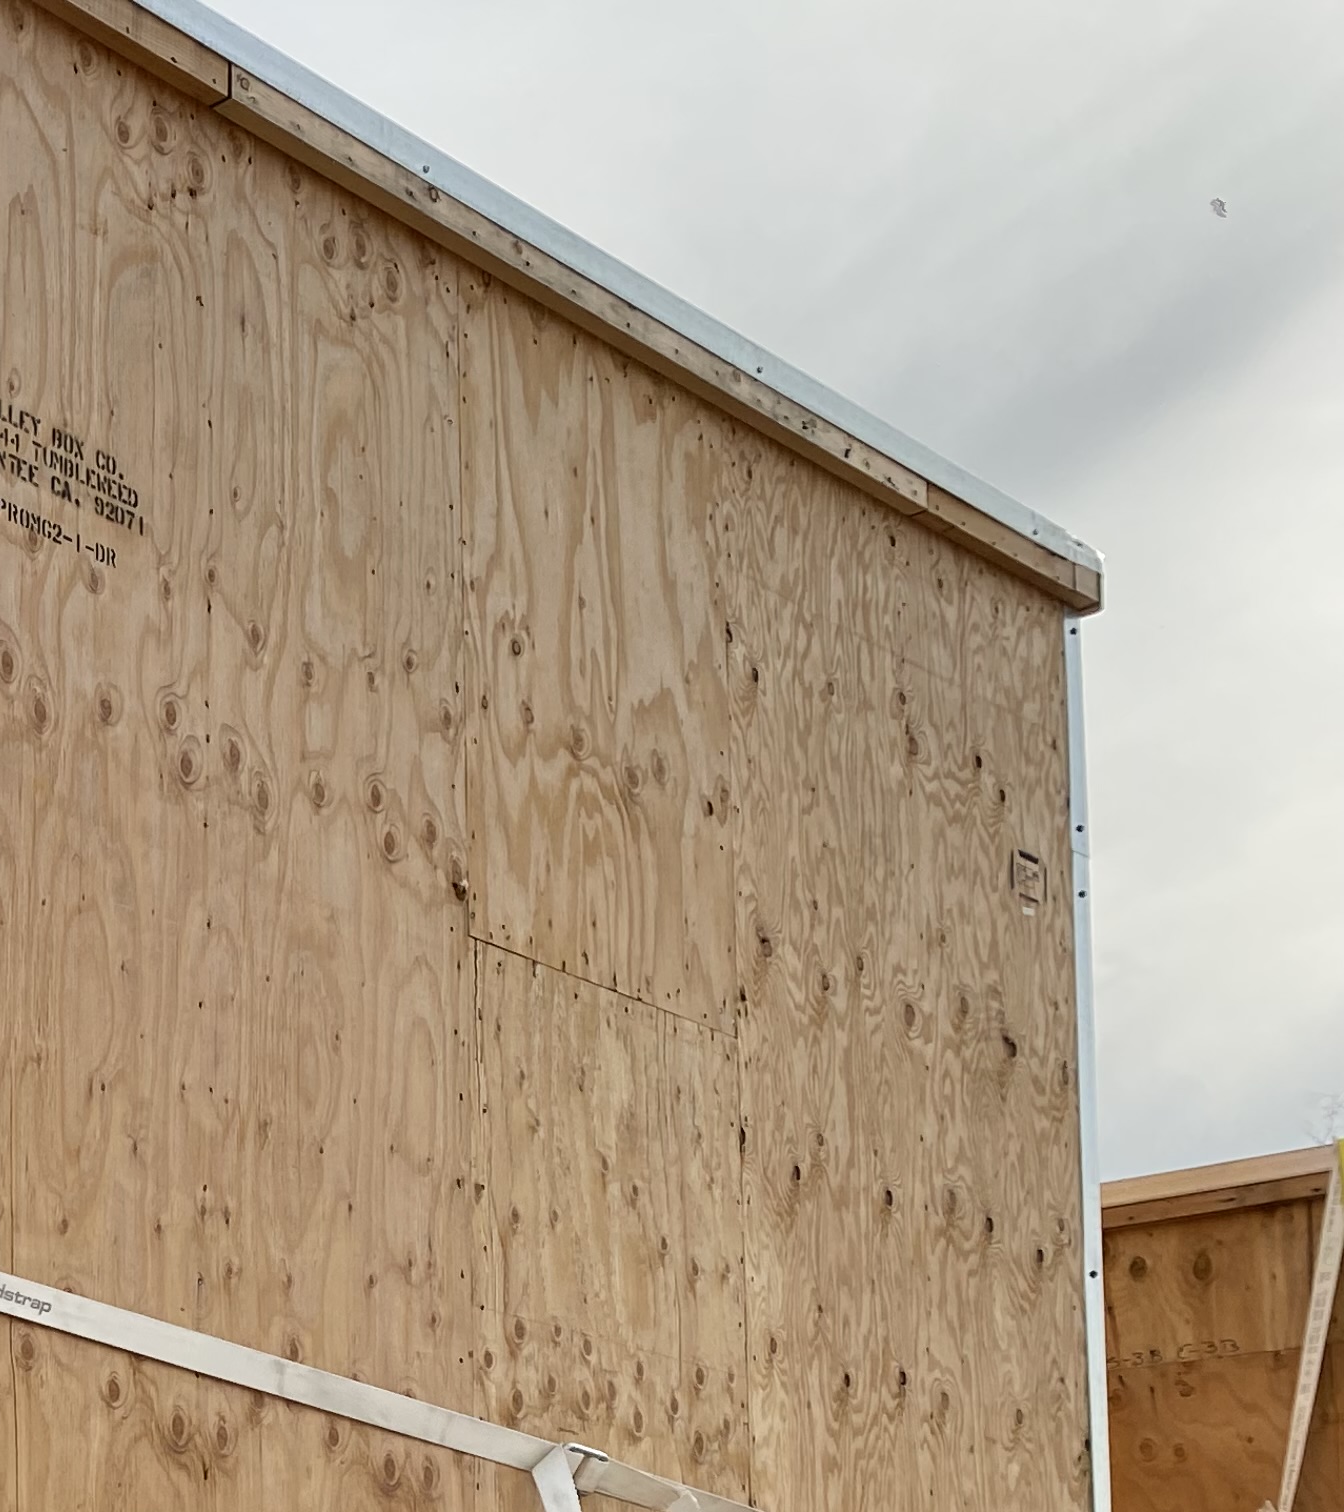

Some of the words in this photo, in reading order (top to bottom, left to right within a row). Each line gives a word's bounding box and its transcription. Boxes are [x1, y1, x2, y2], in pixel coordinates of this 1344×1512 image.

[51, 427, 84, 461] BOX
[95, 449, 124, 480] CO.
[94, 496, 144, 537] 92071
